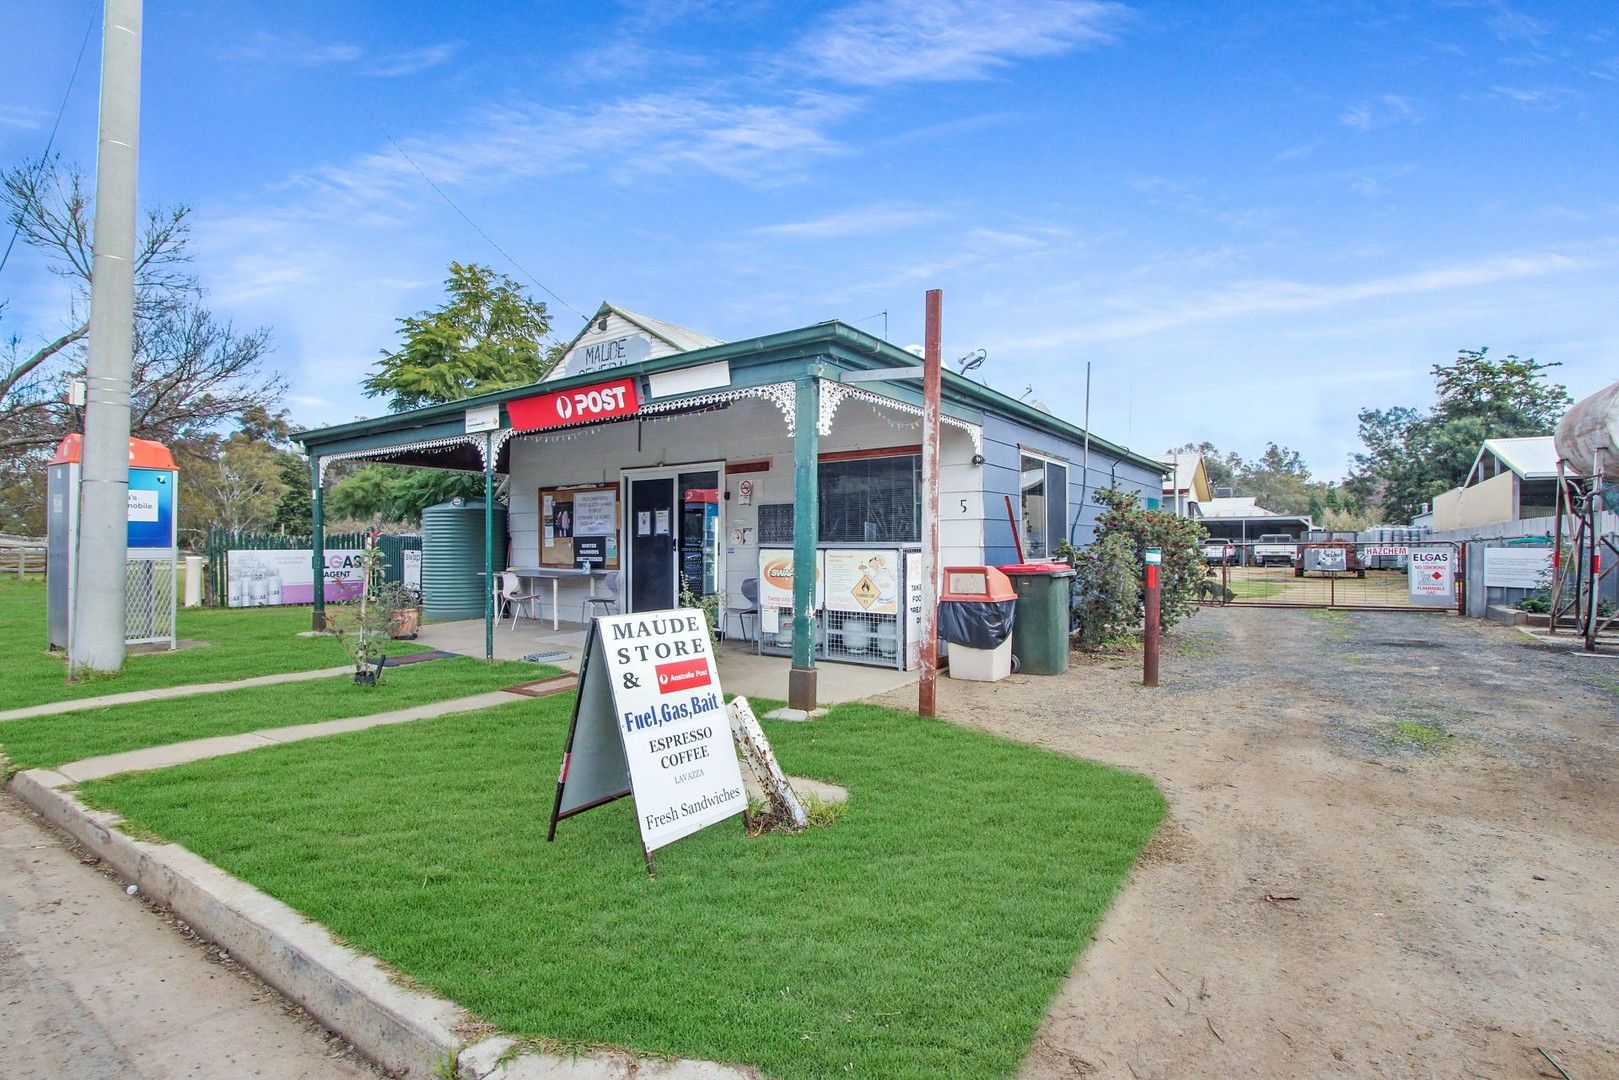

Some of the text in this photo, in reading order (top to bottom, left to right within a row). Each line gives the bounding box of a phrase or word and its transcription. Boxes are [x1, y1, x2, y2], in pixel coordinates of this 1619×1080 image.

[576, 385, 626, 416] POST
[959, 499, 968, 514] 5
[1366, 547, 1407, 555] HAZCHEM
[1413, 553, 1448, 562] ELGAS
[312, 555, 362, 570] LGAS
[323, 570, 351, 579] AGENT
[611, 616, 699, 641] MAUDE
[617, 638, 705, 665] STORE
[622, 672, 641, 690] &
[670, 669, 708, 681] Australia Post
[649, 726, 713, 753] ESPRESSO
[661, 745, 710, 769] COFFEE
[674, 769, 705, 785] LAVAZZA
[645, 787, 741, 831] Fresh Sandwiches
